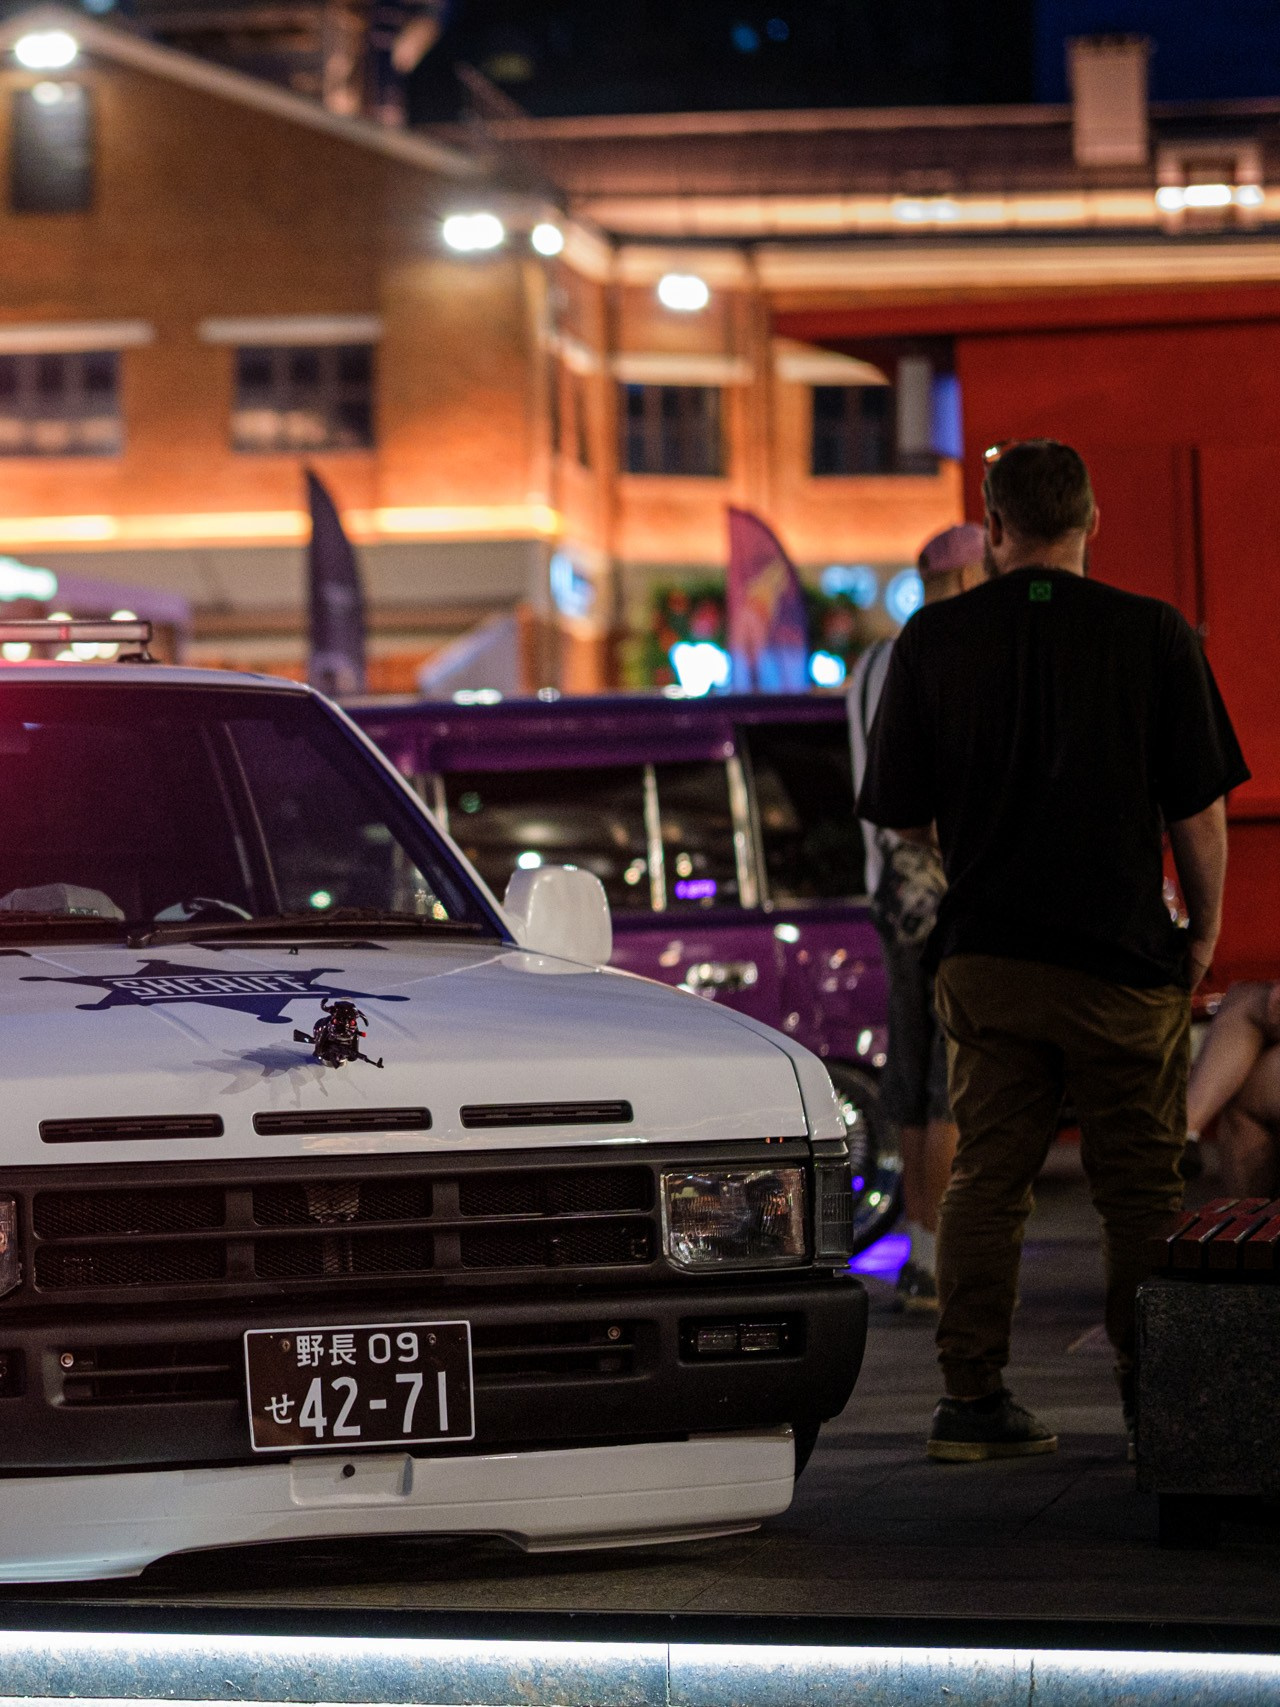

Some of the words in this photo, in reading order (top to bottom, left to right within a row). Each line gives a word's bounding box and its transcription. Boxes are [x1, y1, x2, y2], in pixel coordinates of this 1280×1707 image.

[112, 976, 309, 997] SHERIFF
[295, 1333, 357, 1368] 野長
[368, 1332, 420, 1364] 09
[264, 1393, 295, 1425] せ
[298, 1370, 449, 1438] 42-71
